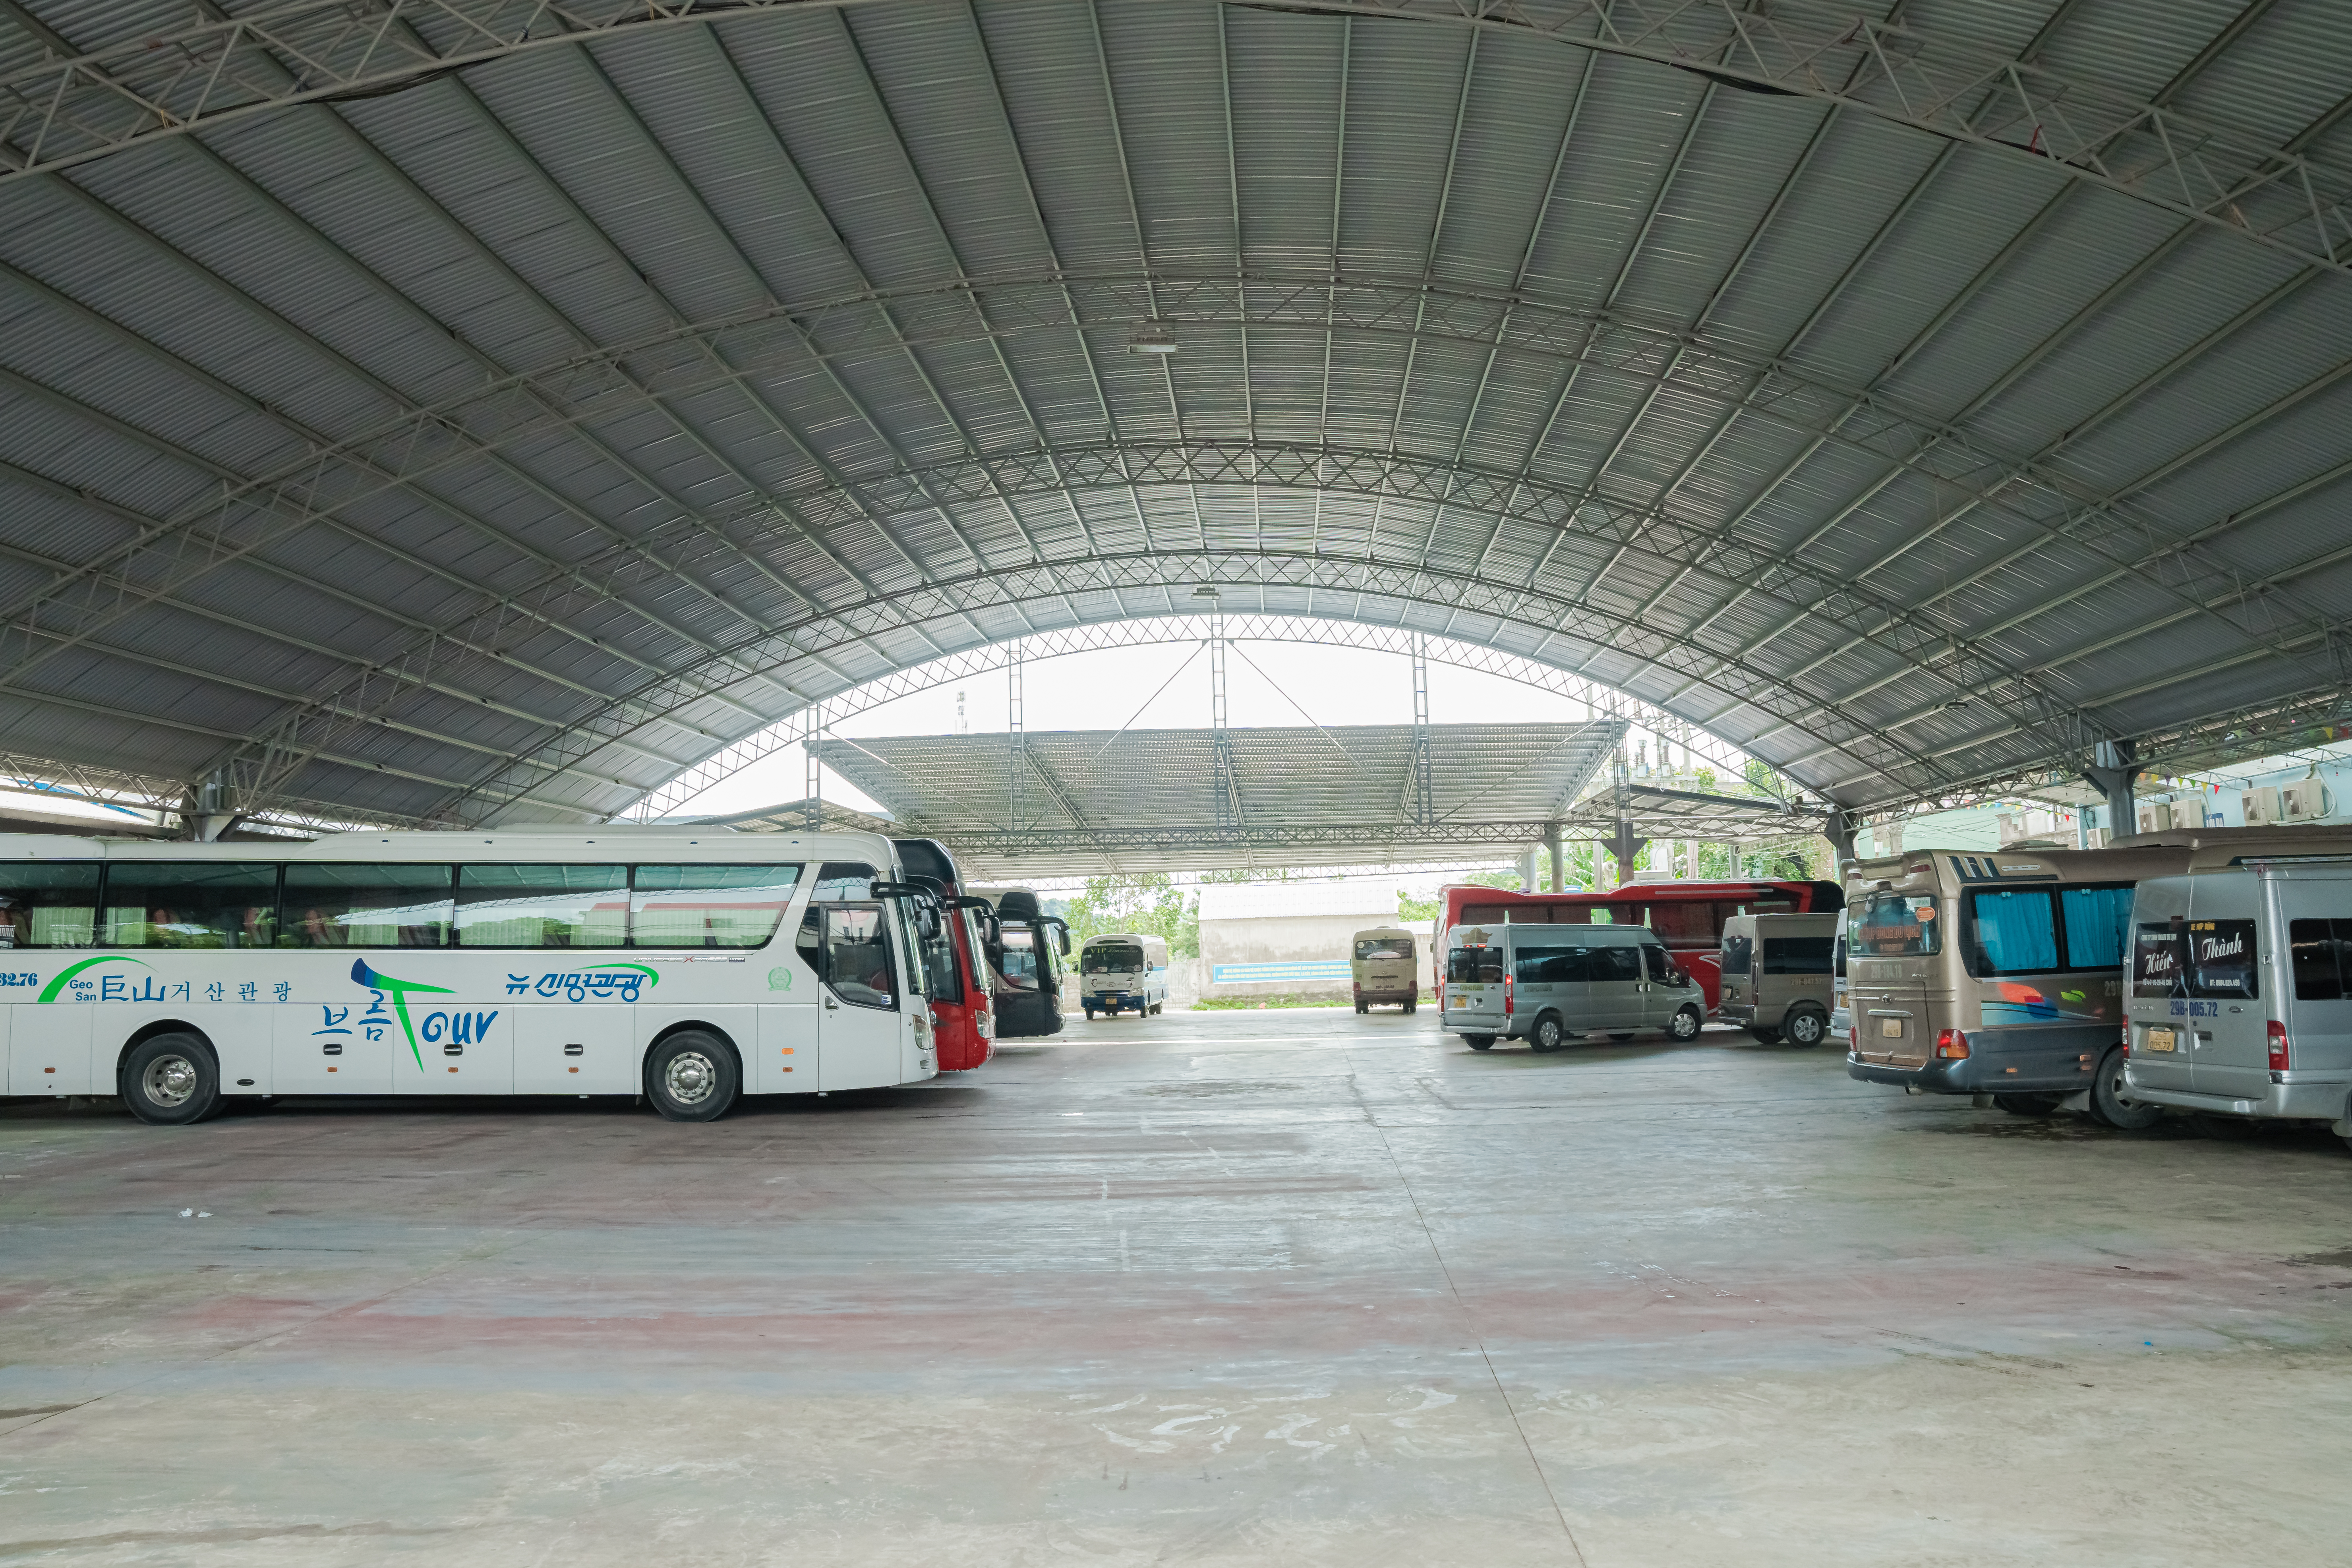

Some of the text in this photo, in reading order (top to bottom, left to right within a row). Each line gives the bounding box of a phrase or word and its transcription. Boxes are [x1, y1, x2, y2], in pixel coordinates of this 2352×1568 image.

[2202, 932, 2243, 960] Thành
[70, 980, 93, 989] Geo
[75, 992, 96, 1001] San
[2170, 1001, 2218, 1017] 29B-005.72
[2150, 1041, 2170, 1050] 005.72
